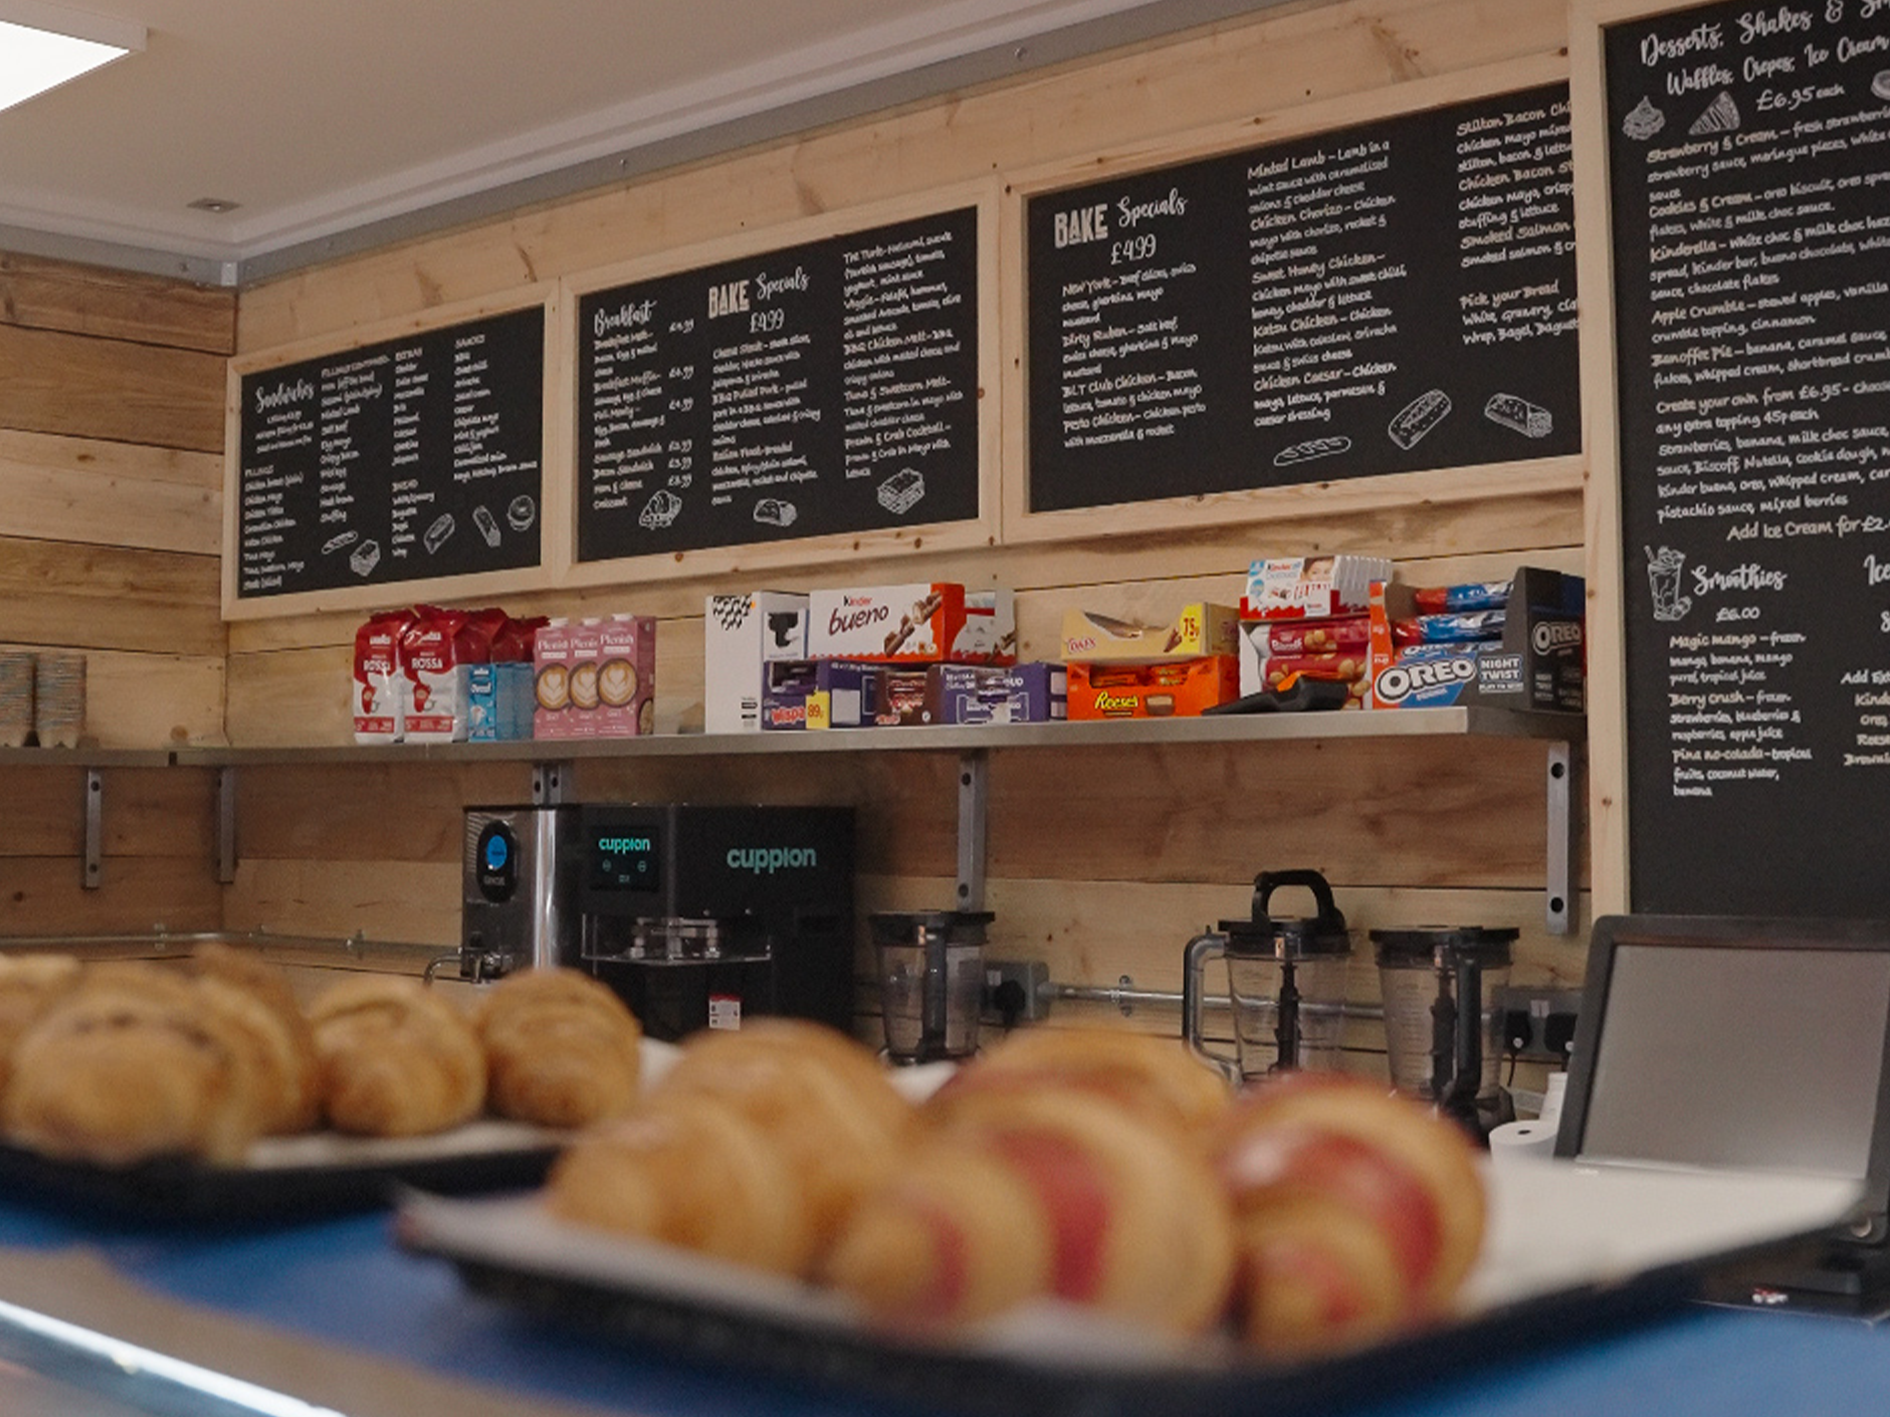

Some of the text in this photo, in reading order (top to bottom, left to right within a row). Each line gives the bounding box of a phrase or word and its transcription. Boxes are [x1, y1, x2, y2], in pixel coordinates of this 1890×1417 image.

[1735, 6, 1813, 44] Shakes
[1825, 0, 1844, 24] &
[1804, 43, 1829, 67] Ice
[1756, 83, 1845, 111] £6.95 each
[1456, 109, 1547, 136] Stilton Bacon
[1646, 121, 1823, 163] Strawberry & Cream fresh
[1647, 164, 1709, 182] strawberry
[1750, 147, 1809, 163] meringue
[1850, 129, 1886, 145] white
[1247, 140, 1391, 180] Minted Lamb Lamb in a
[1458, 165, 1555, 191] Chicken Bacon
[1054, 187, 1188, 249] BAKE Specials
[1250, 212, 1297, 231] Chicken
[1299, 203, 1343, 221] Chorizo
[1458, 202, 1560, 230] stuffing & lettuce
[1649, 200, 1696, 218] Cookies
[1699, 197, 1709, 213] &
[1711, 192, 1753, 208] Cream
[1460, 221, 1571, 250] Smoked Salmon
[1252, 253, 1377, 285] Sweet Honey Chicken
[708, 265, 811, 319] BAKE Specials
[1459, 278, 1560, 310] Pick your Bread
[594, 299, 658, 337] Breakfast
[1253, 323, 1288, 339] Katsu
[1290, 314, 1338, 331] Chicken
[1651, 300, 1745, 326] Apple Crumble
[868, 336, 903, 350] Chicken
[1652, 328, 1699, 344] crumble
[1751, 314, 1816, 331] cinnamon
[1650, 344, 1733, 367] Banoffee Pie
[1061, 373, 1157, 398] BLT Club Chicken
[1253, 373, 1300, 392] Chicken
[1303, 368, 1345, 384] Caesar
[255, 378, 315, 414] Sandwiches
[1656, 398, 1696, 414] Create
[1698, 397, 1731, 416] your
[1731, 392, 1759, 406] own
[1762, 386, 1795, 407] from
[1063, 418, 1090, 434] Pesto
[1092, 412, 1135, 428] Chicken
[1181, 402, 1207, 418] pesto
[1656, 407, 1819, 438] any extra topping 45p each
[1768, 472, 1817, 489] whipped
[1657, 502, 1715, 524] pistachio
[1760, 496, 1800, 513] mixed
[1804, 493, 1848, 508] berries
[1726, 515, 1861, 541] Add Ice Cream for
[1690, 563, 1787, 596] Smoothies
[828, 605, 889, 636] bueno
[1533, 621, 1582, 655] OREO
[1669, 633, 1710, 651] Magic
[1712, 633, 1757, 649] mango
[412, 657, 443, 670] ROSSA
[1481, 657, 1521, 669] NIGHT
[1481, 670, 1521, 681] TWIST
[1374, 658, 1477, 703] OREO
[1668, 692, 1706, 710] Berry
[598, 837, 650, 854] cuppion
[726, 847, 817, 874] cuppion
